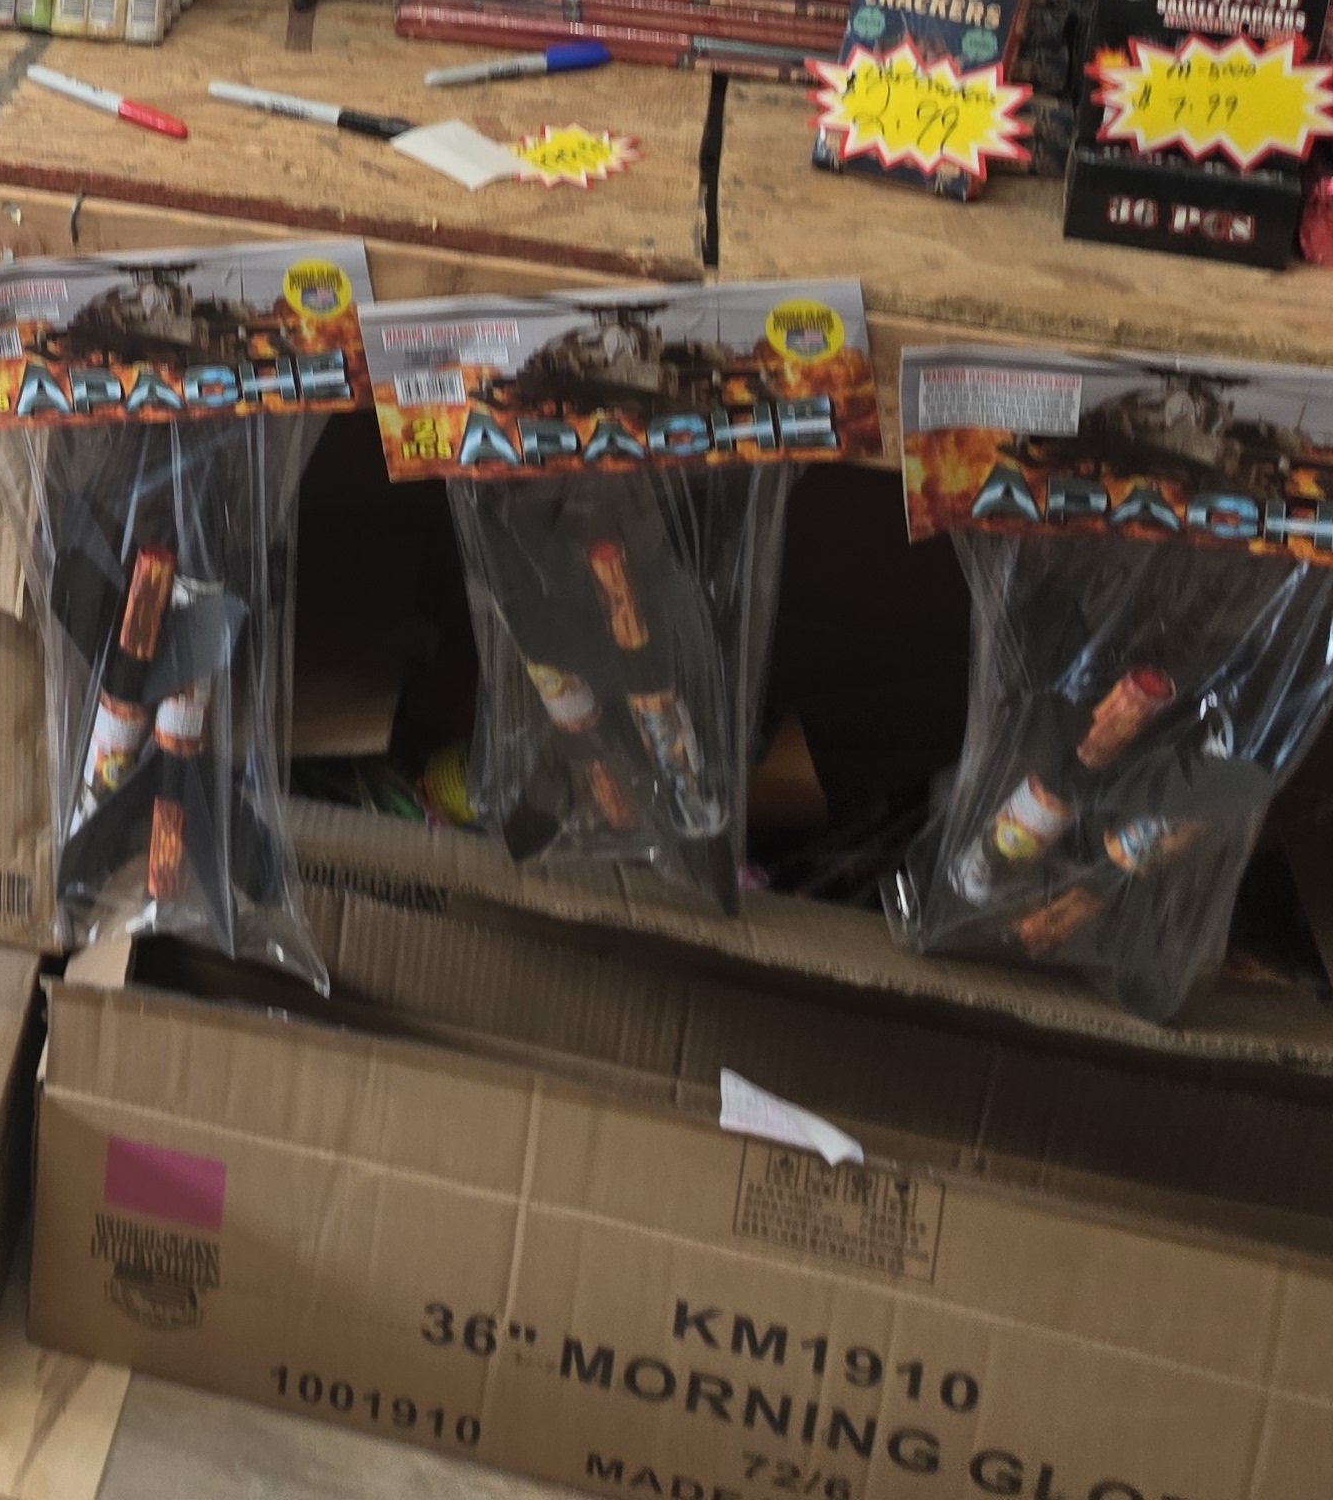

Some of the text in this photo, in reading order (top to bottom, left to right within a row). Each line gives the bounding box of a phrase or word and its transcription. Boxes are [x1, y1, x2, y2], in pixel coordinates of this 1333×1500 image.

[1170, 204, 1255, 242] PCS
[16, 347, 351, 417] APACHE
[457, 396, 837, 467] APACHE
[420, 1301, 941, 1476] 36" MORNING
[673, 1299, 981, 1415] KM1910
[270, 1364, 483, 1449] 1001910
